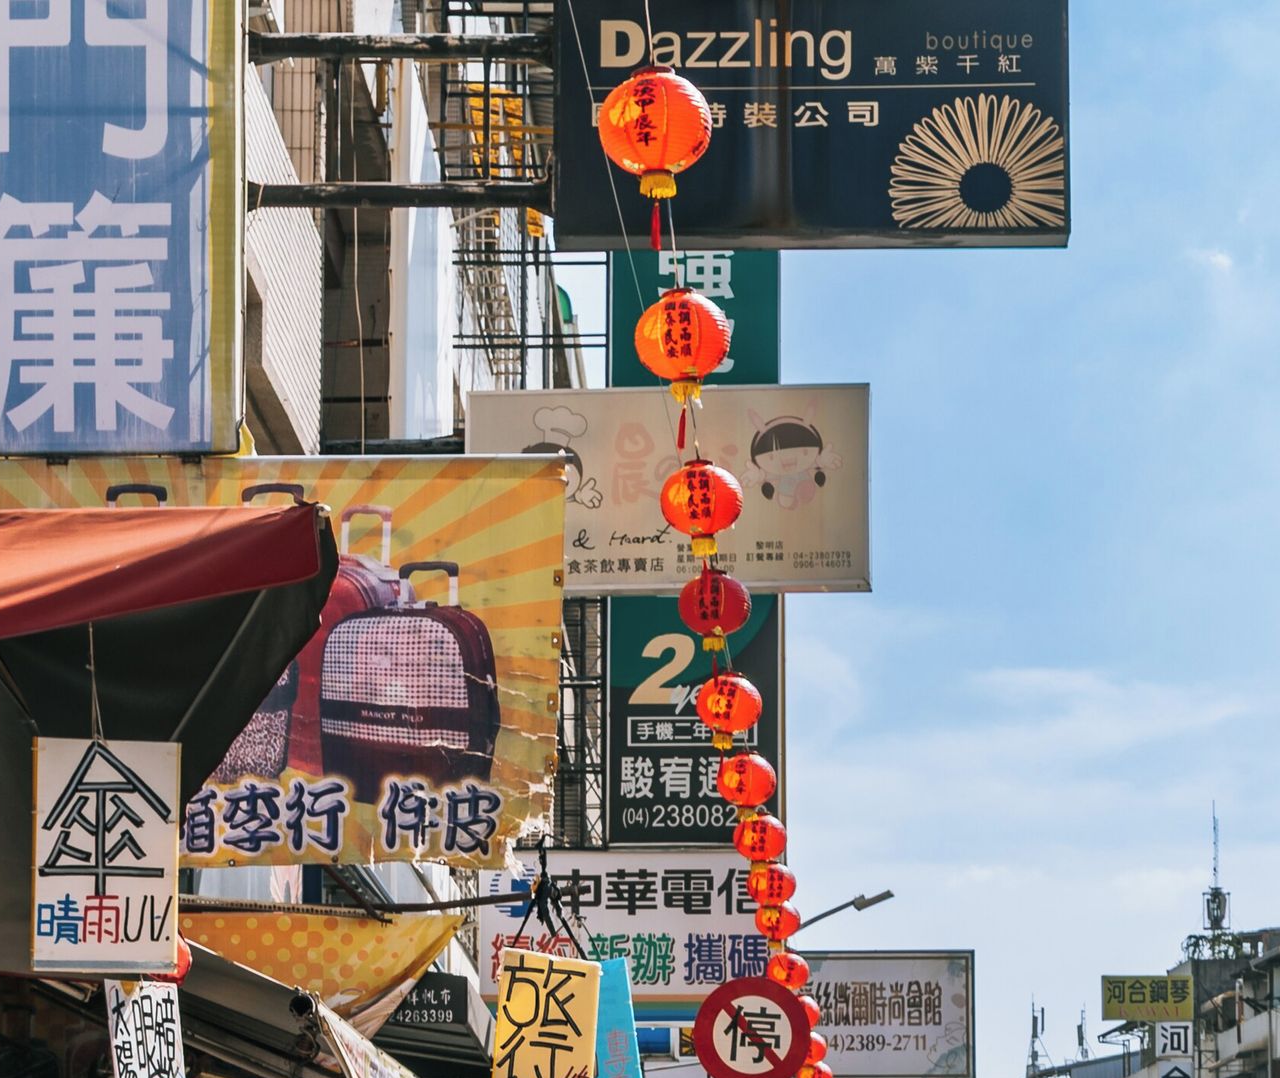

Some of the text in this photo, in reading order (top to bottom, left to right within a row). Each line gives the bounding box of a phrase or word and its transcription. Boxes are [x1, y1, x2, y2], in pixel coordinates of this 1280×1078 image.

[600, 19, 853, 80] Dazzling
[874, 54, 1022, 76] 萬紫千紅
[926, 30, 1033, 52] boutique
[38, 739, 172, 897] 傘
[550, 868, 760, 916] 中華電信
[1107, 979, 1190, 1004] 河合鋼琴
[723, 1004, 781, 1064] 停
